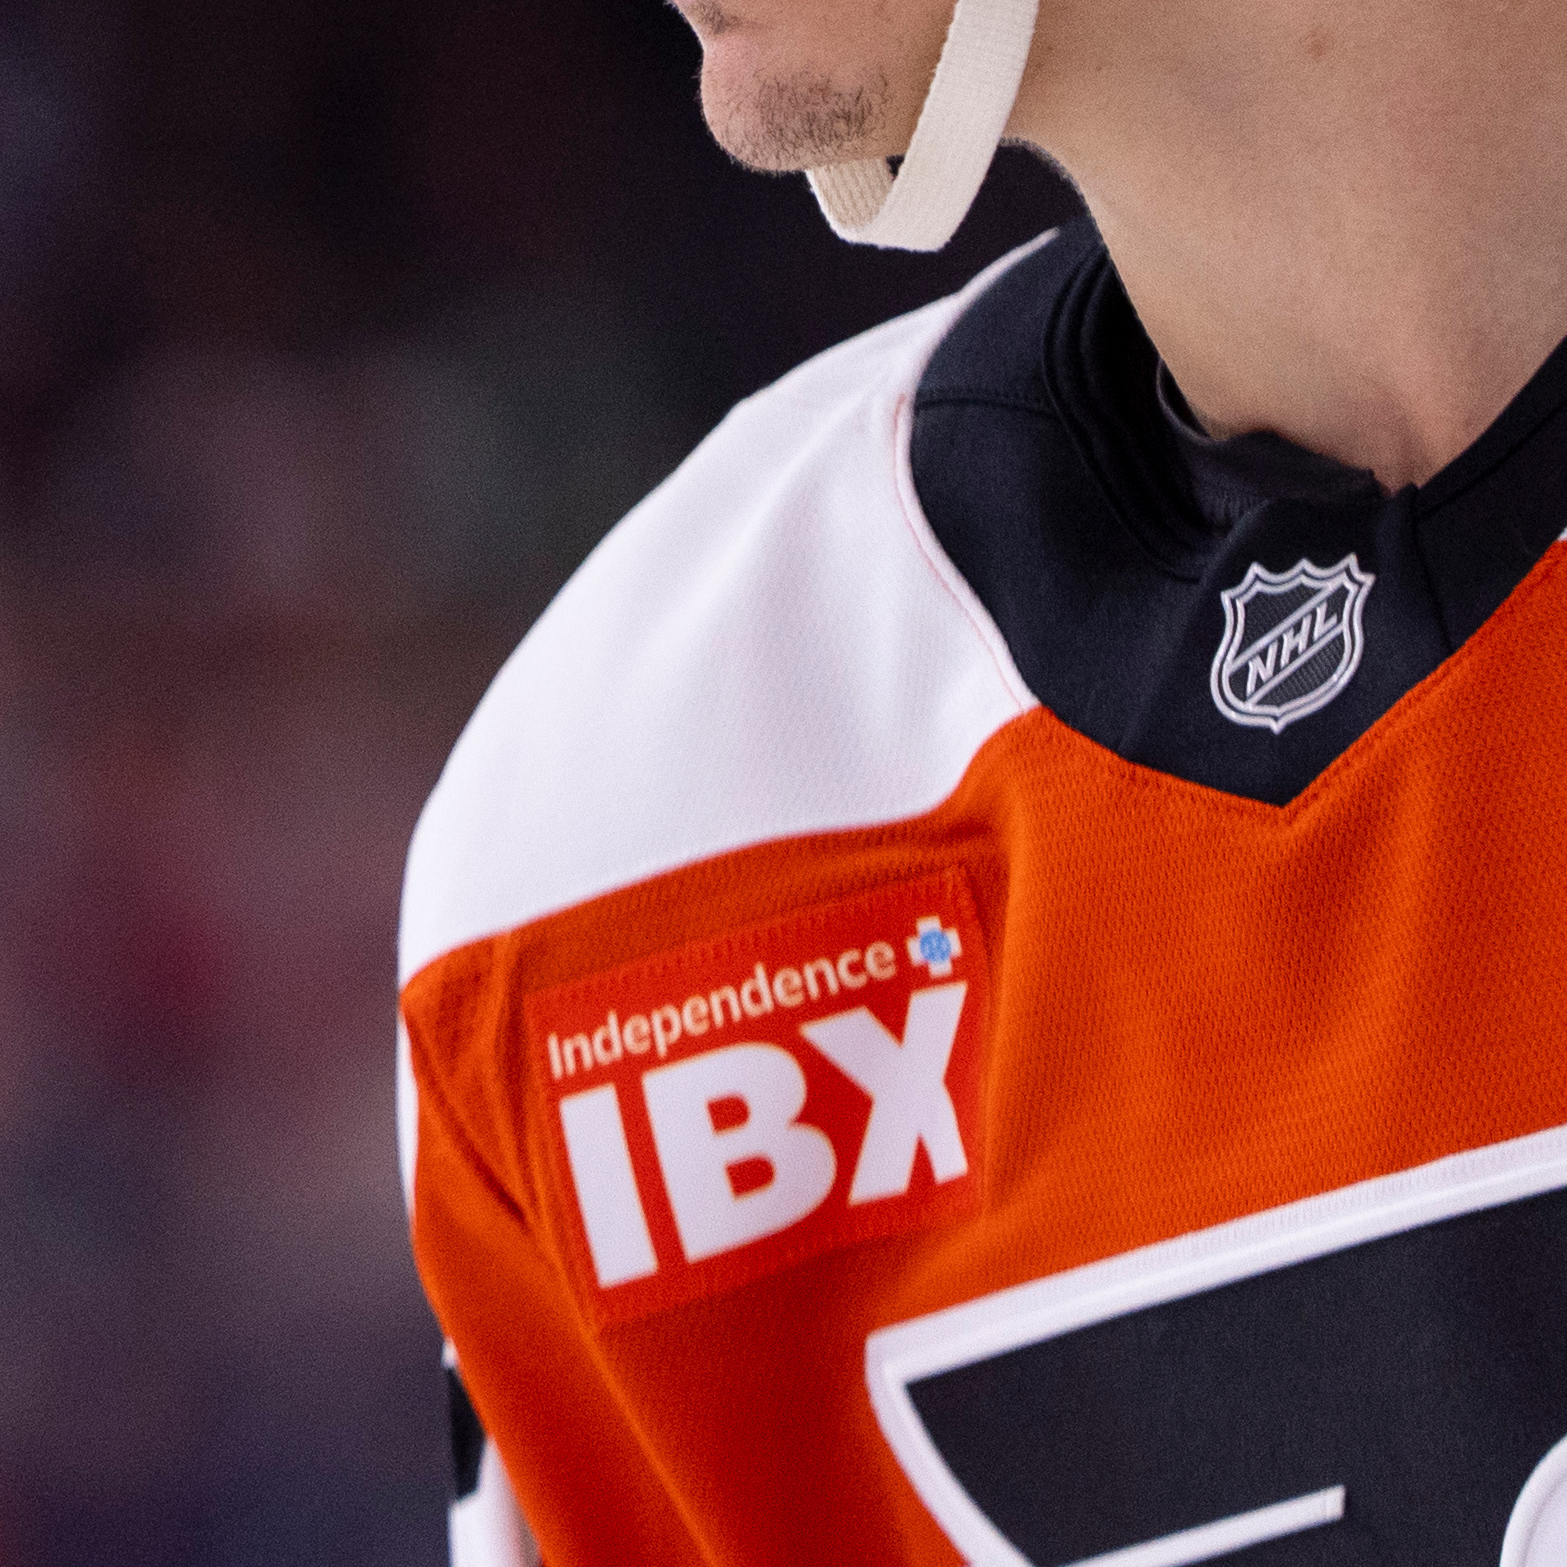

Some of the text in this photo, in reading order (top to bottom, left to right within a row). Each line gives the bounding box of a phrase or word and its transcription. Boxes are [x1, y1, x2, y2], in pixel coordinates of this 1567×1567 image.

[1245, 600, 1338, 696] NHL
[546, 940, 897, 1082] Independence
[558, 980, 970, 1290] IBX
